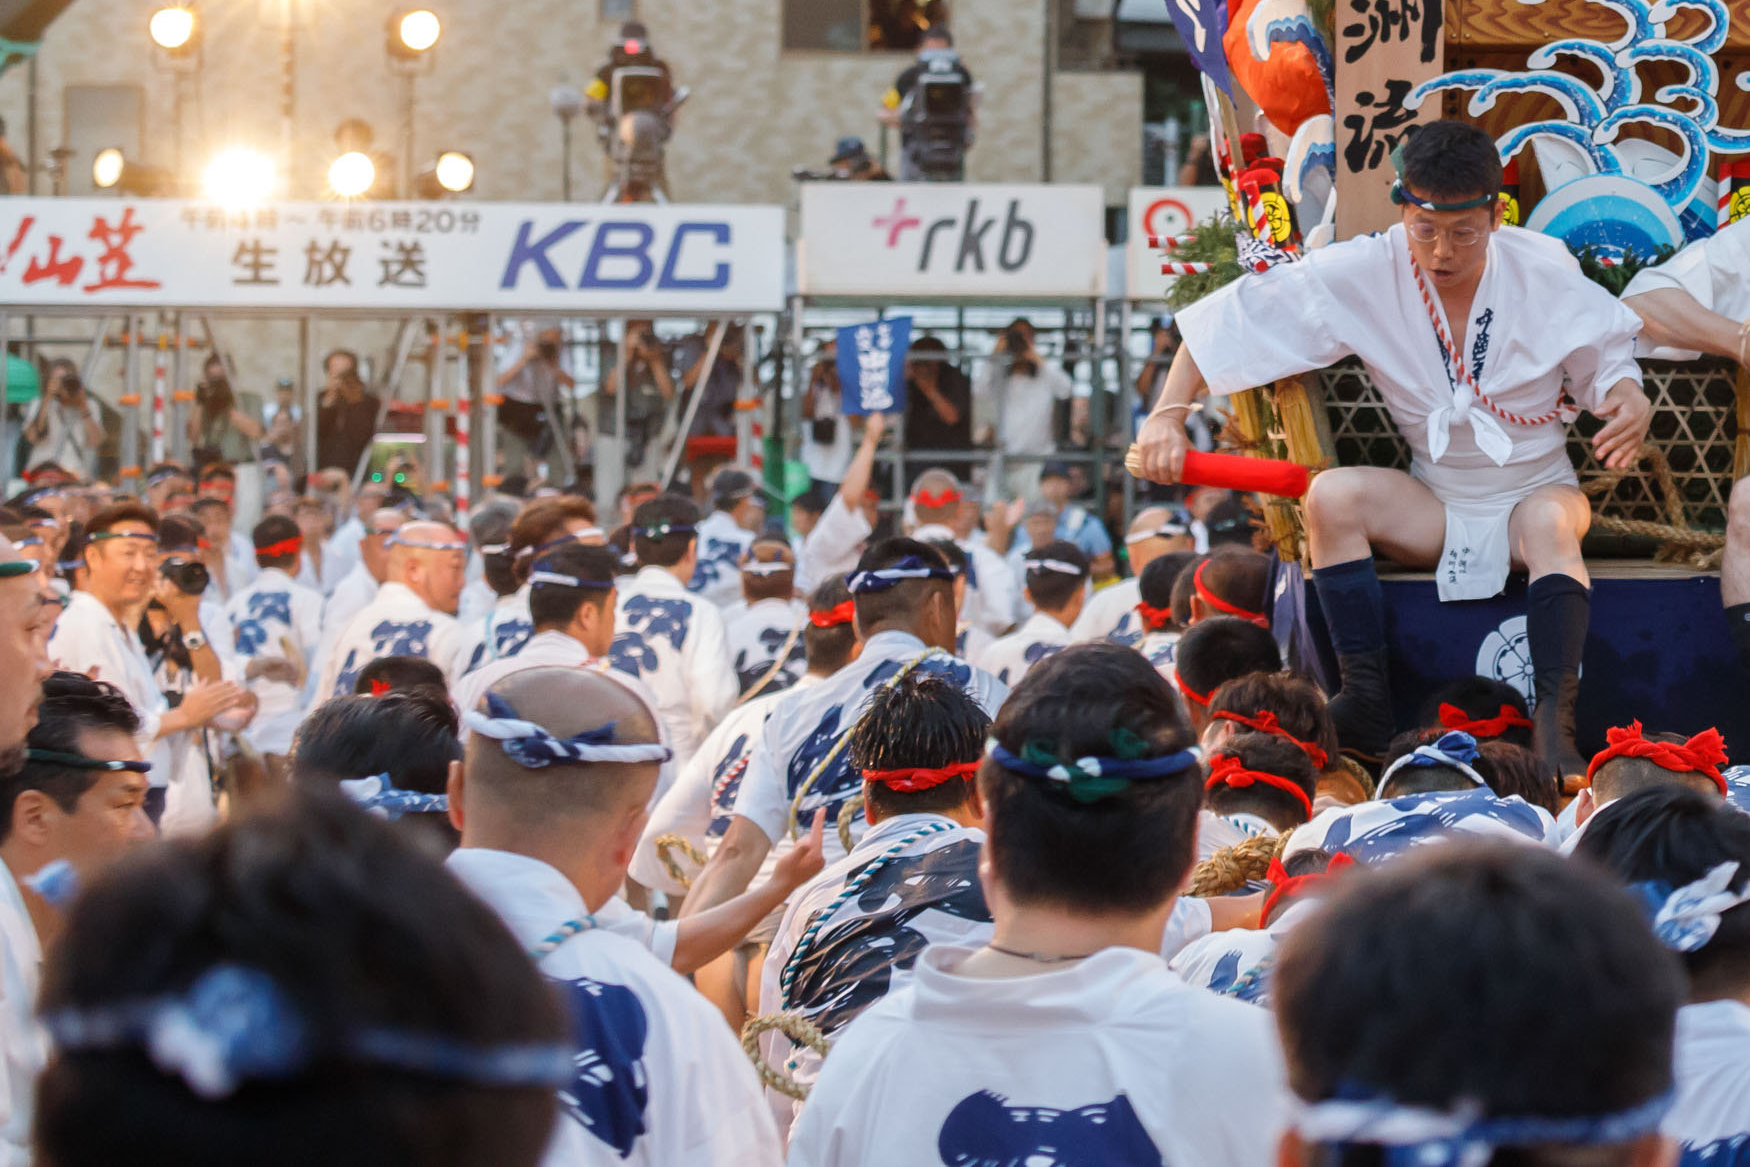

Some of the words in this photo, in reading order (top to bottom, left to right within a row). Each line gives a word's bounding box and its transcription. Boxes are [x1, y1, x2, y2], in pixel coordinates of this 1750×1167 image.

[231, 238, 428, 289] 生放送
[500, 221, 731, 290] KBC
